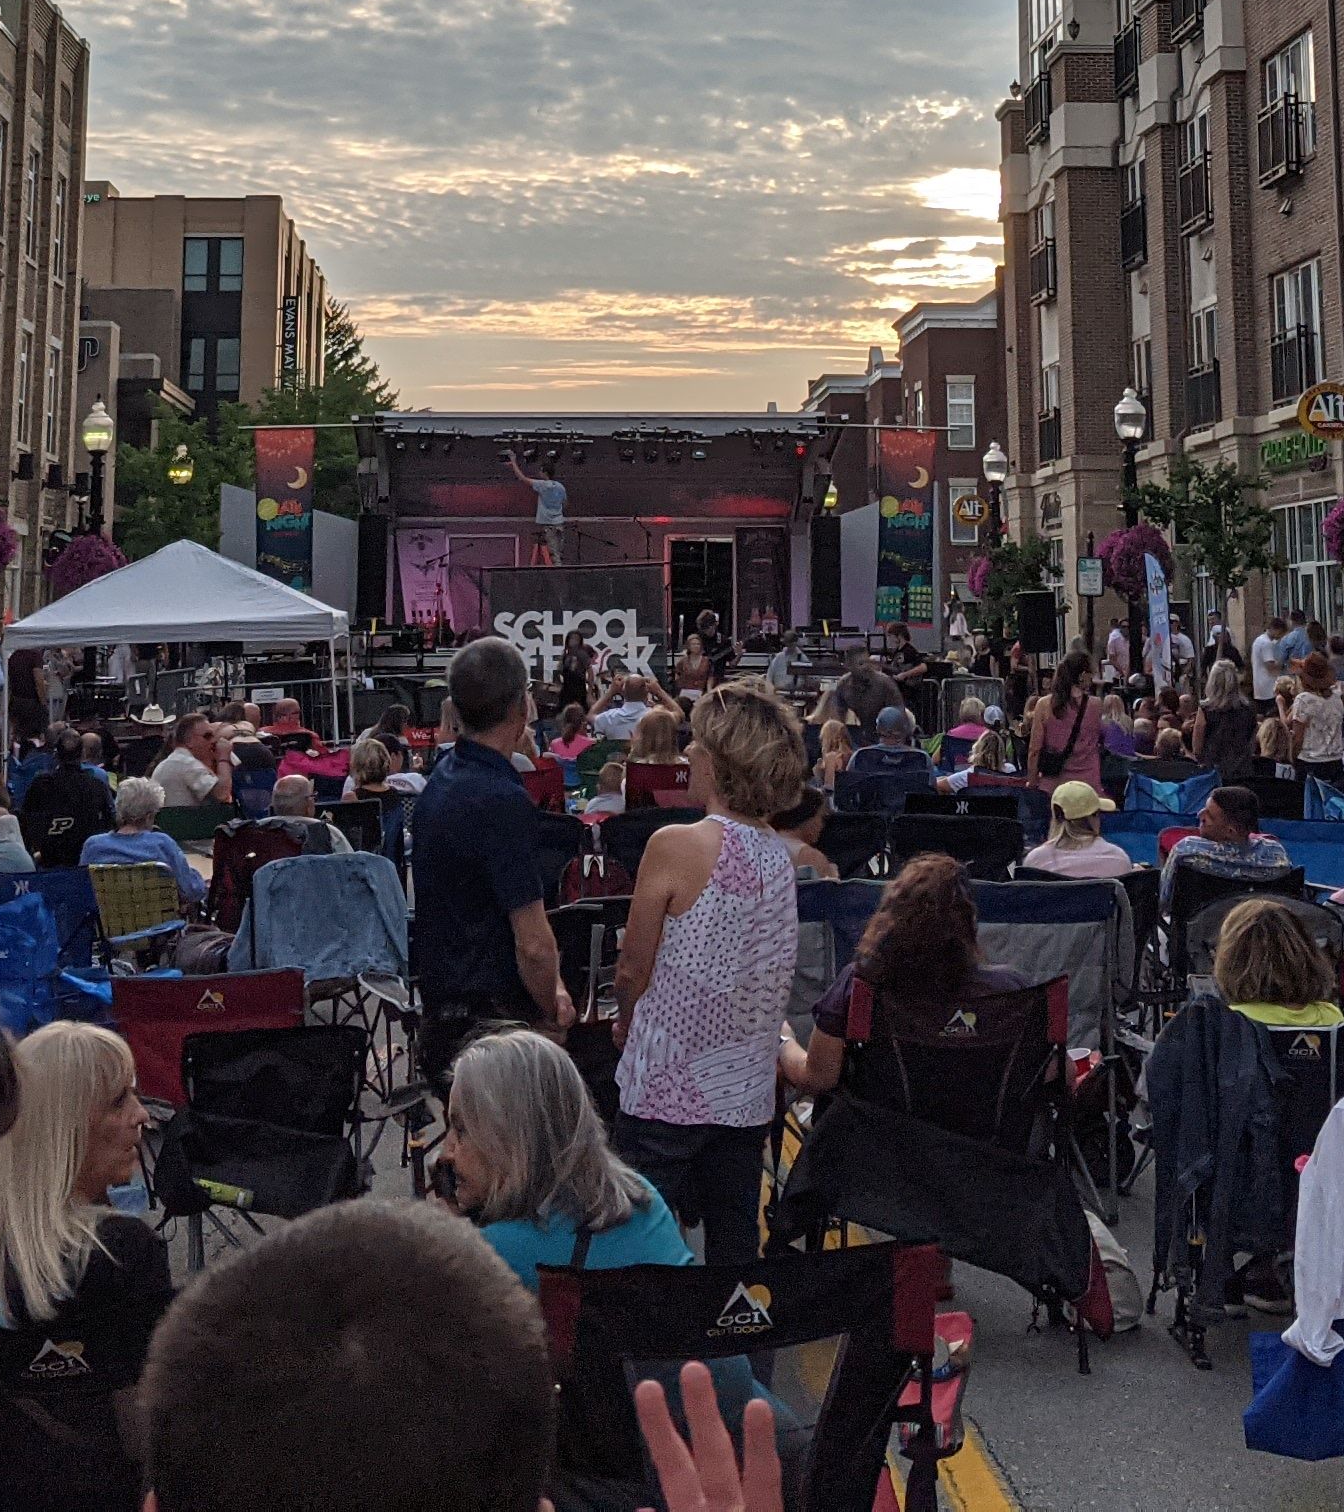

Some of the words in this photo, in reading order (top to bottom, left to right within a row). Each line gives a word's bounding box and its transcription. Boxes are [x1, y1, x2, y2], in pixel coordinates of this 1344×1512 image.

[285, 298, 296, 339] EVANS
[284, 343, 296, 370] MAY
[959, 500, 982, 517] Art
[493, 608, 649, 651] SCHOOL
[717, 1311, 761, 1327] GCI
